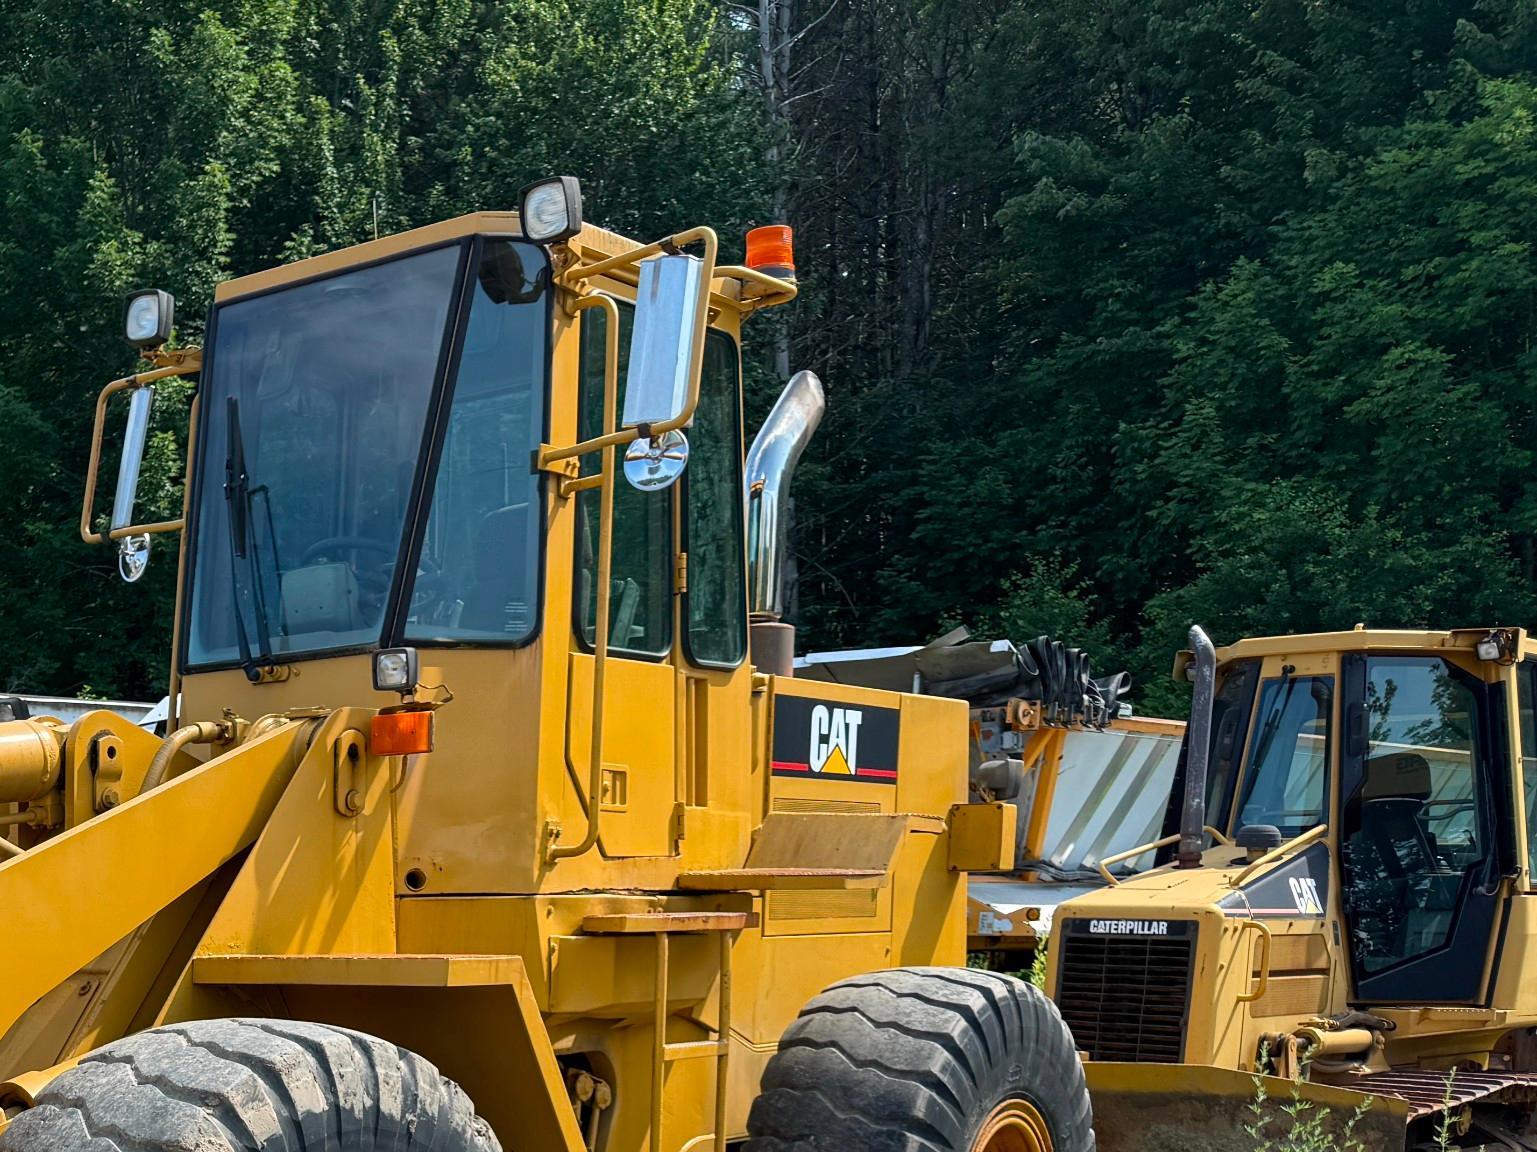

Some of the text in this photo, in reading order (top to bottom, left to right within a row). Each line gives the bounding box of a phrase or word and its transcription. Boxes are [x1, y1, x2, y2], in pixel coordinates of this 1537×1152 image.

[809, 704, 863, 776] CAT
[1288, 876, 1324, 914] CAT
[1089, 919, 1168, 935] CATERPILLAR
